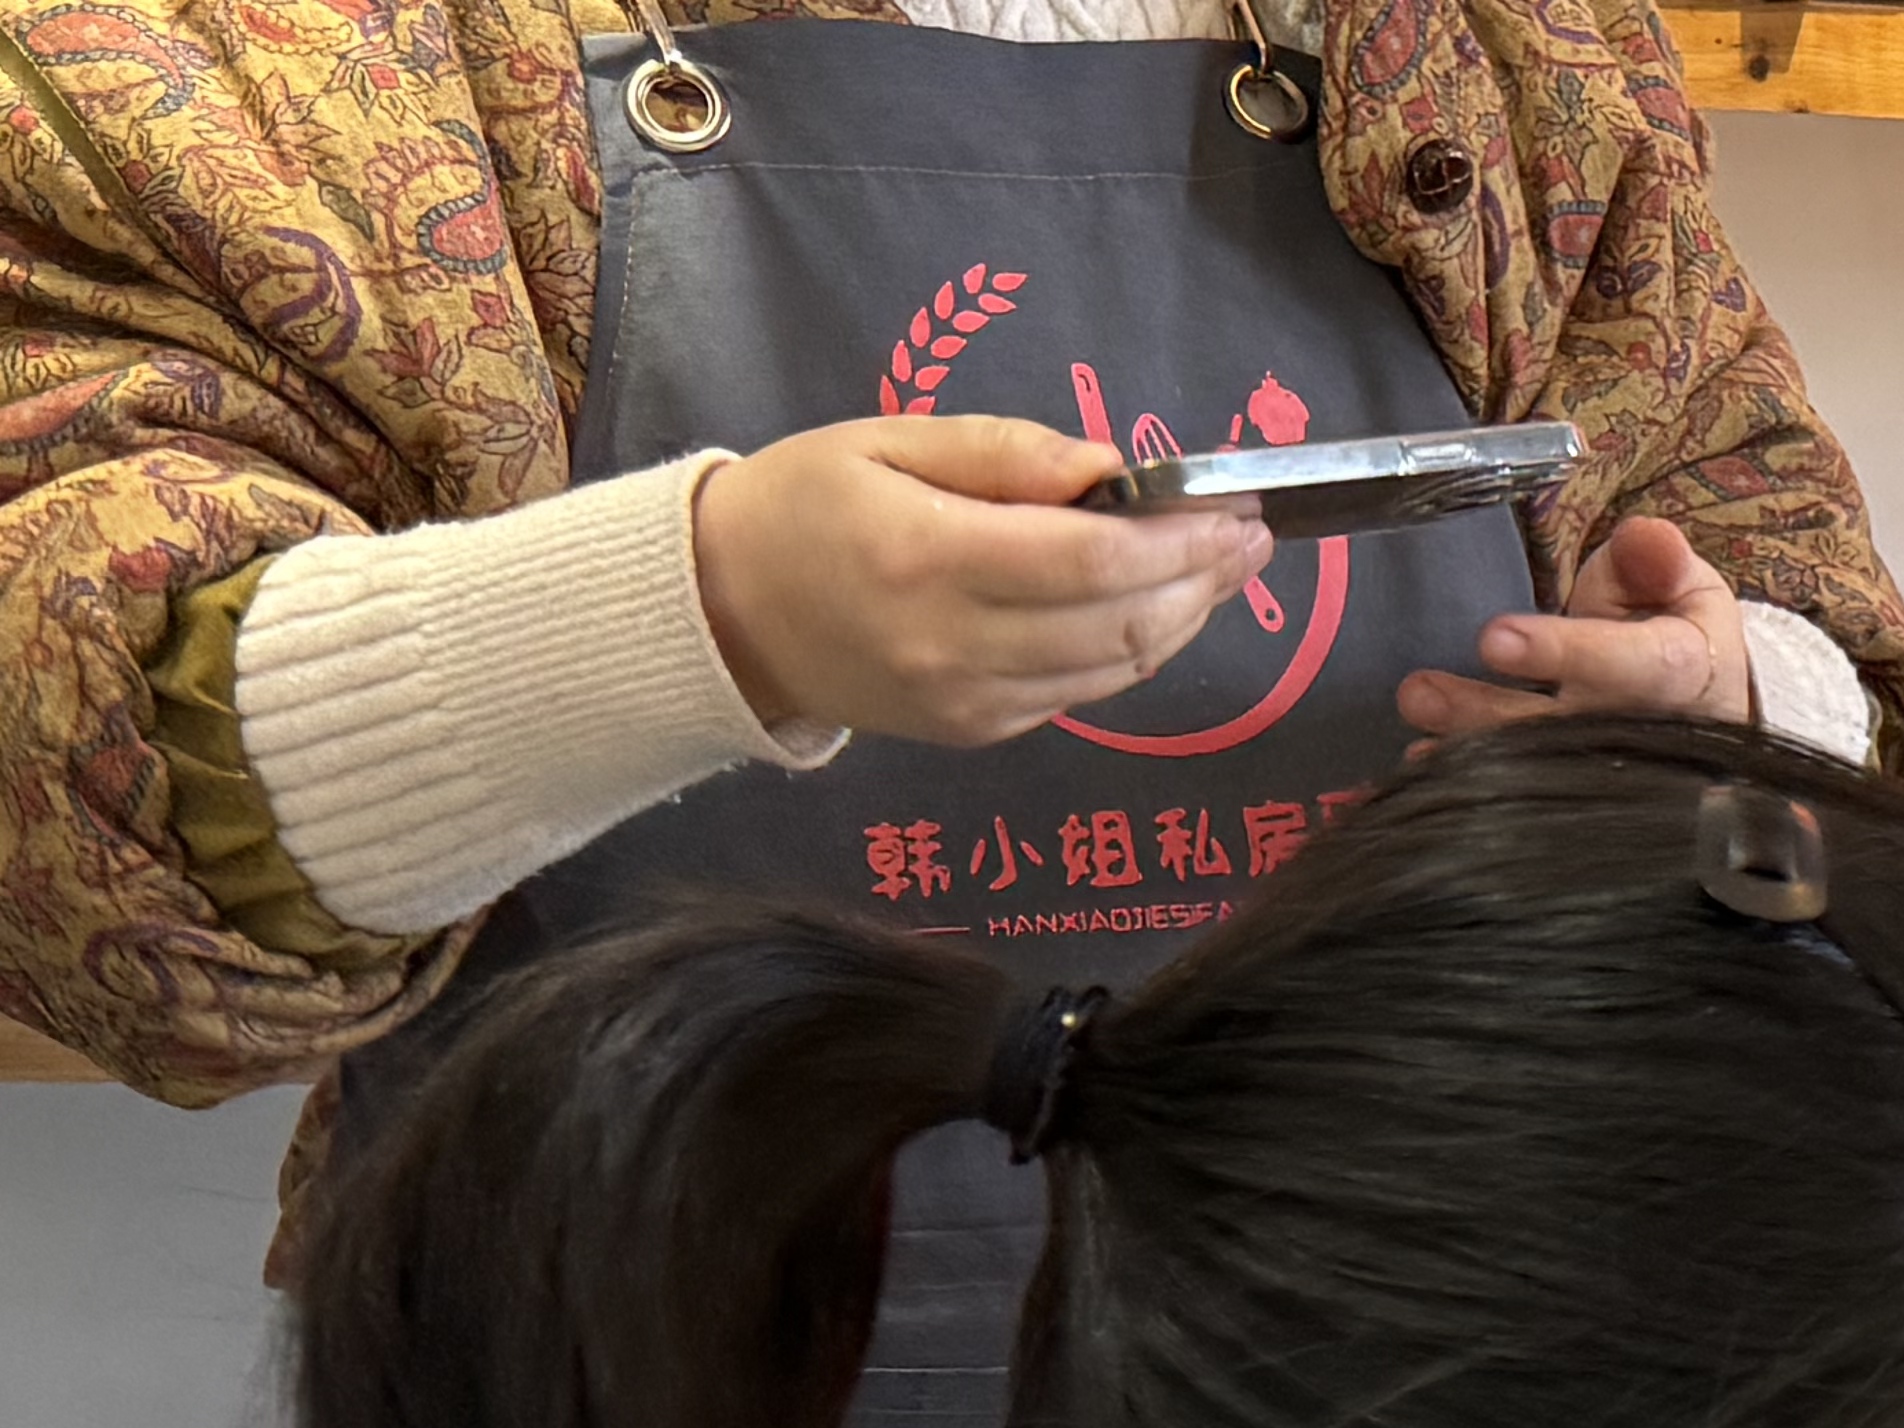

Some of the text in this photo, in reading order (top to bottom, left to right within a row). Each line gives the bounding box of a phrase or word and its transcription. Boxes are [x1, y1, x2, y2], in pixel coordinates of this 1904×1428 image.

[864, 788, 1352, 901] 韩小姐私房
